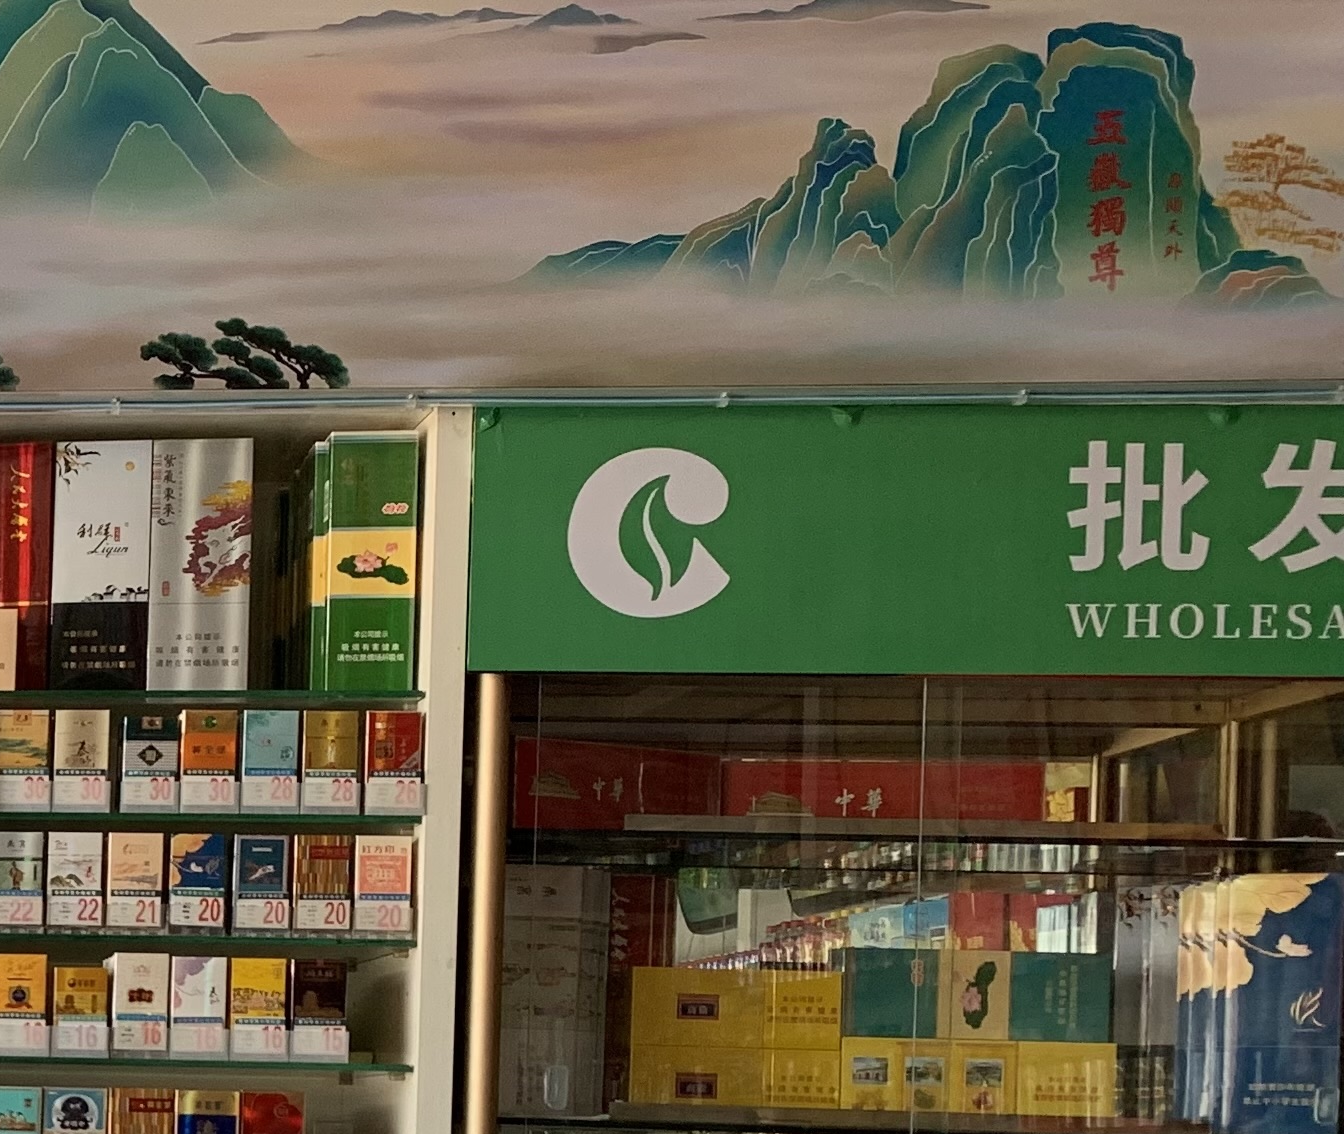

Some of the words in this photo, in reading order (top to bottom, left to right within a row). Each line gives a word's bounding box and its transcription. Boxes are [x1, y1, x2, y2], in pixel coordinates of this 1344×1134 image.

[1067, 438, 1344, 573] 批发
[87, 540, 129, 557] Liqun
[1066, 602, 1344, 641] WHOLESA
[199, 899, 221, 921] 20
[144, 1024, 160, 1044] 16
